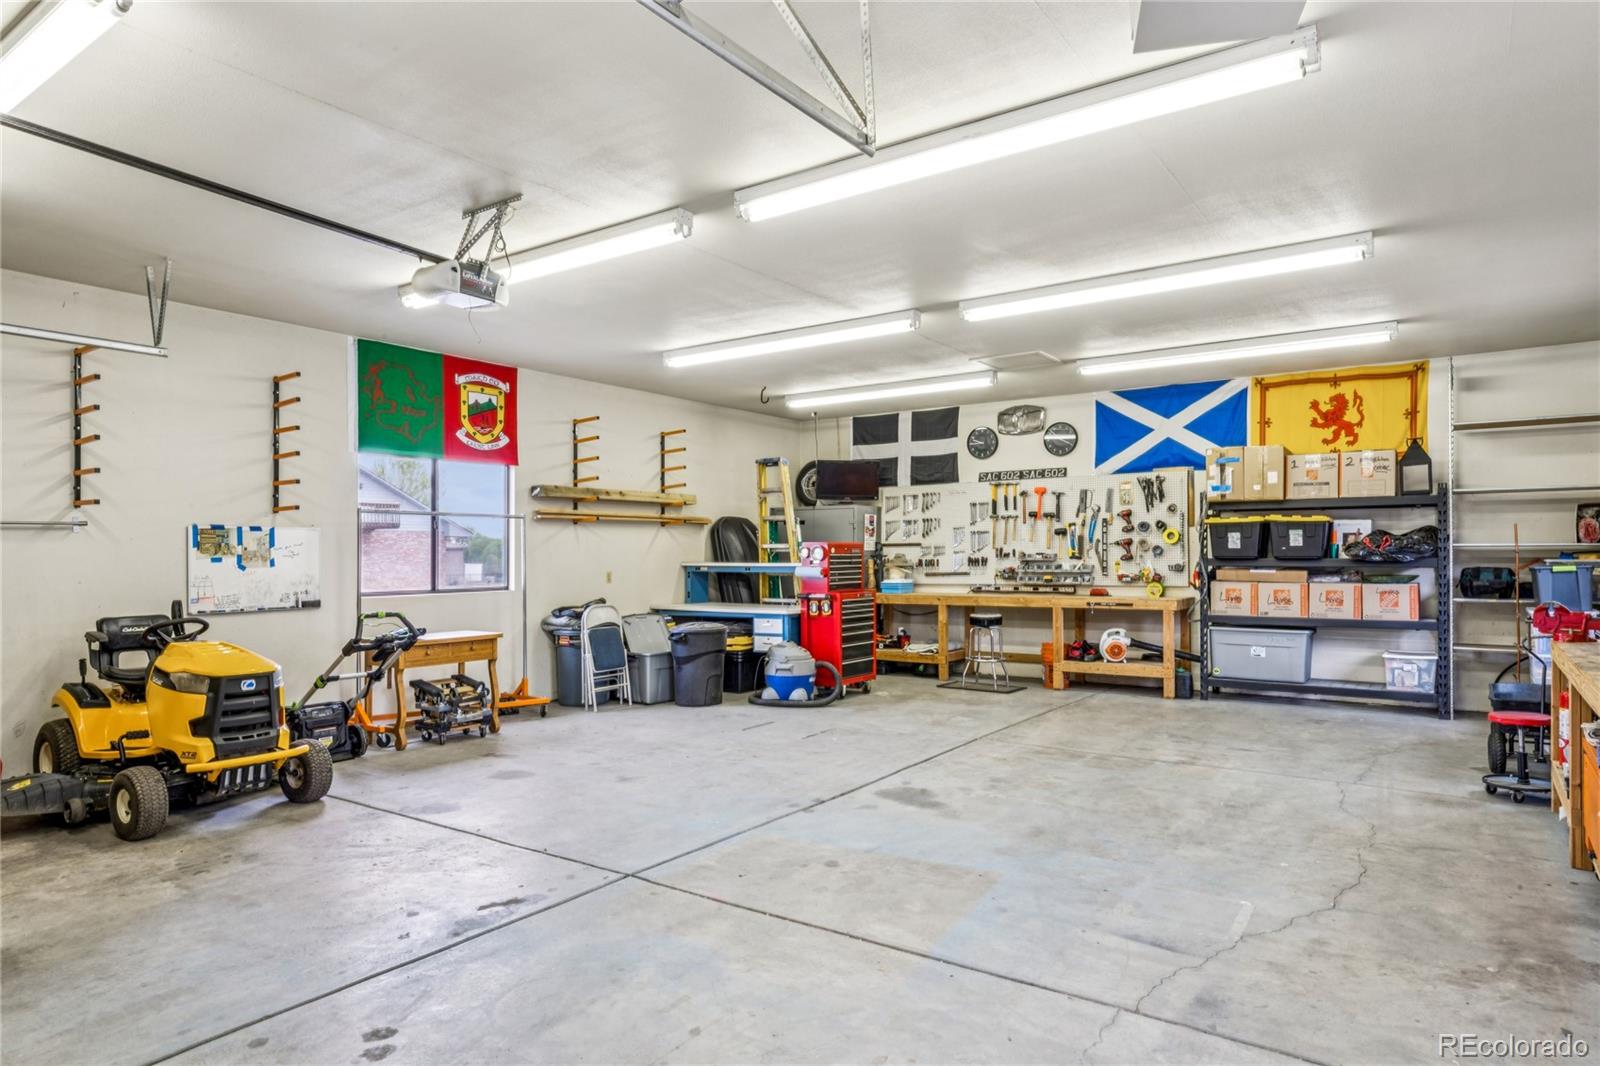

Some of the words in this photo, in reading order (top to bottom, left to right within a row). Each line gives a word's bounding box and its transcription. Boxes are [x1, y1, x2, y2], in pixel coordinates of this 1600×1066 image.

[1344, 456, 1355, 467] 2
[980, 472, 999, 481] SAC
[1000, 470, 1020, 480] 602
[1021, 470, 1043, 479] SAC
[1044, 468, 1065, 477] 602
